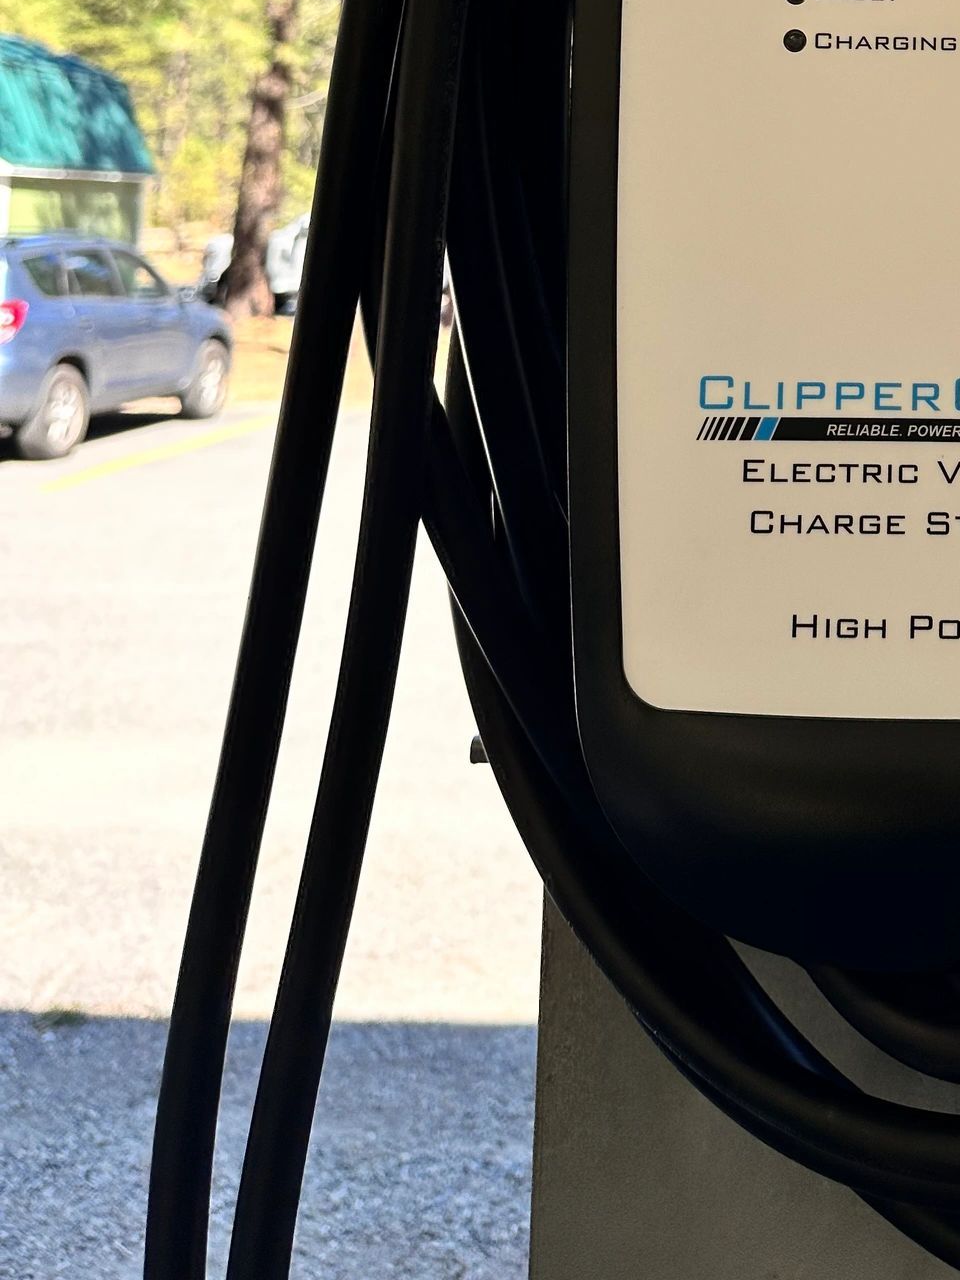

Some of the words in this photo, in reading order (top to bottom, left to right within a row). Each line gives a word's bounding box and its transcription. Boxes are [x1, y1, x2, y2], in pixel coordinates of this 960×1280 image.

[814, 32, 957, 51] CHARGING
[826, 424, 902, 437] RELIABLE.
[742, 459, 919, 484] ELECTRIC
[750, 510, 906, 535] CHARGE
[791, 614, 887, 639] HIGH
